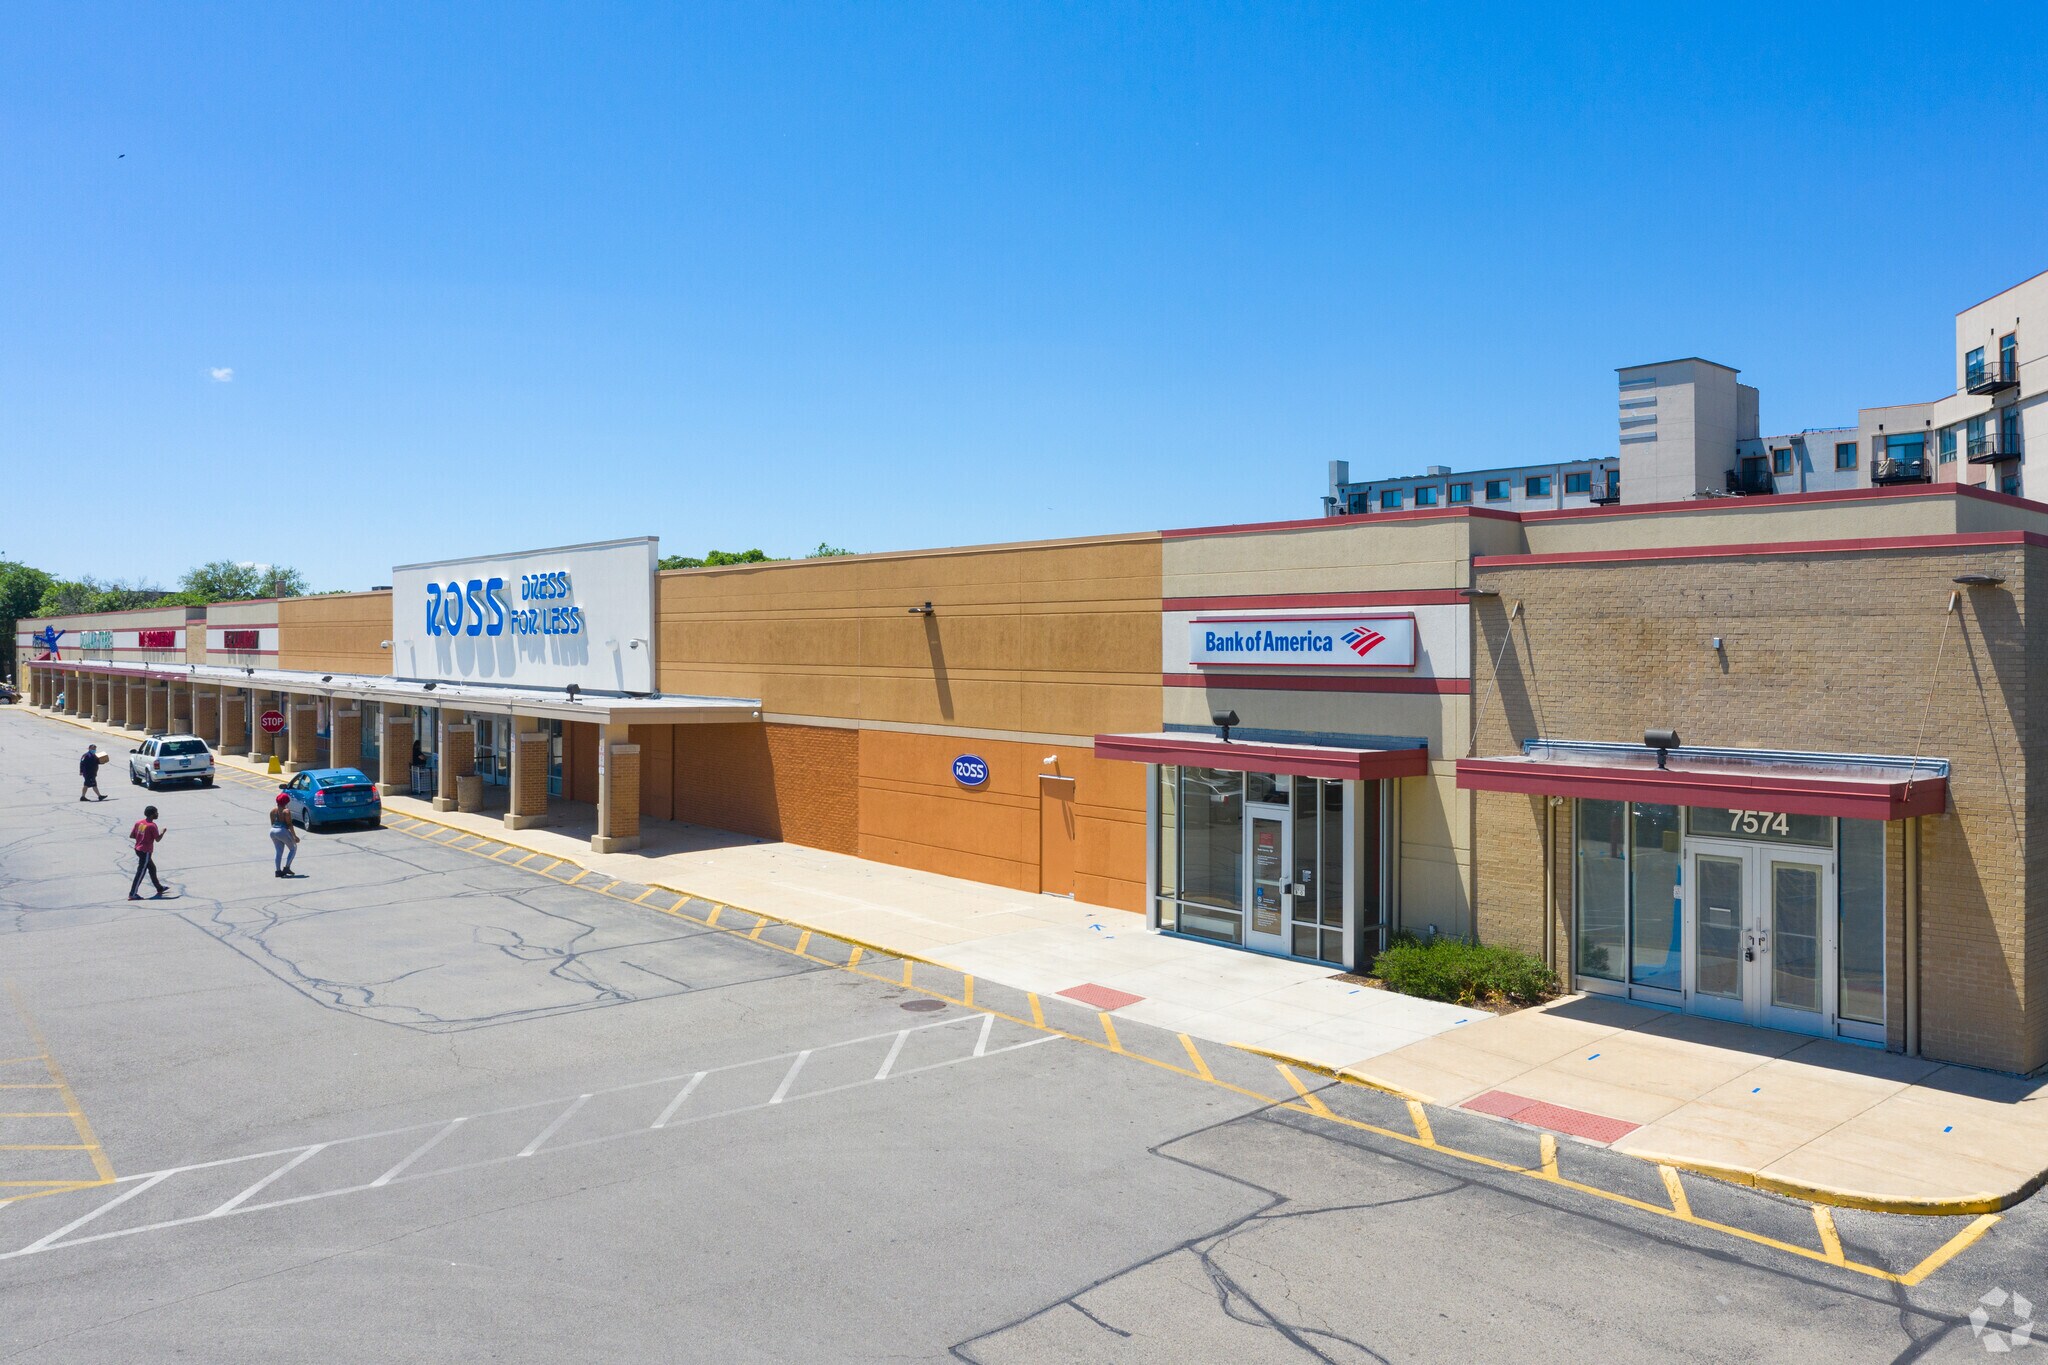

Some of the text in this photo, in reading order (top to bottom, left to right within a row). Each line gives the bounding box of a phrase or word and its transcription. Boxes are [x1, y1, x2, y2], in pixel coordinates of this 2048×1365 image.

[522, 571, 568, 601] DRESS
[426, 577, 504, 637] ROSS
[511, 606, 580, 636] FOR LESS
[1205, 630, 1333, 652] Bank of America
[261, 717, 283, 727] STOP
[955, 761, 984, 779] ROSS
[1728, 809, 1790, 837] 7574
